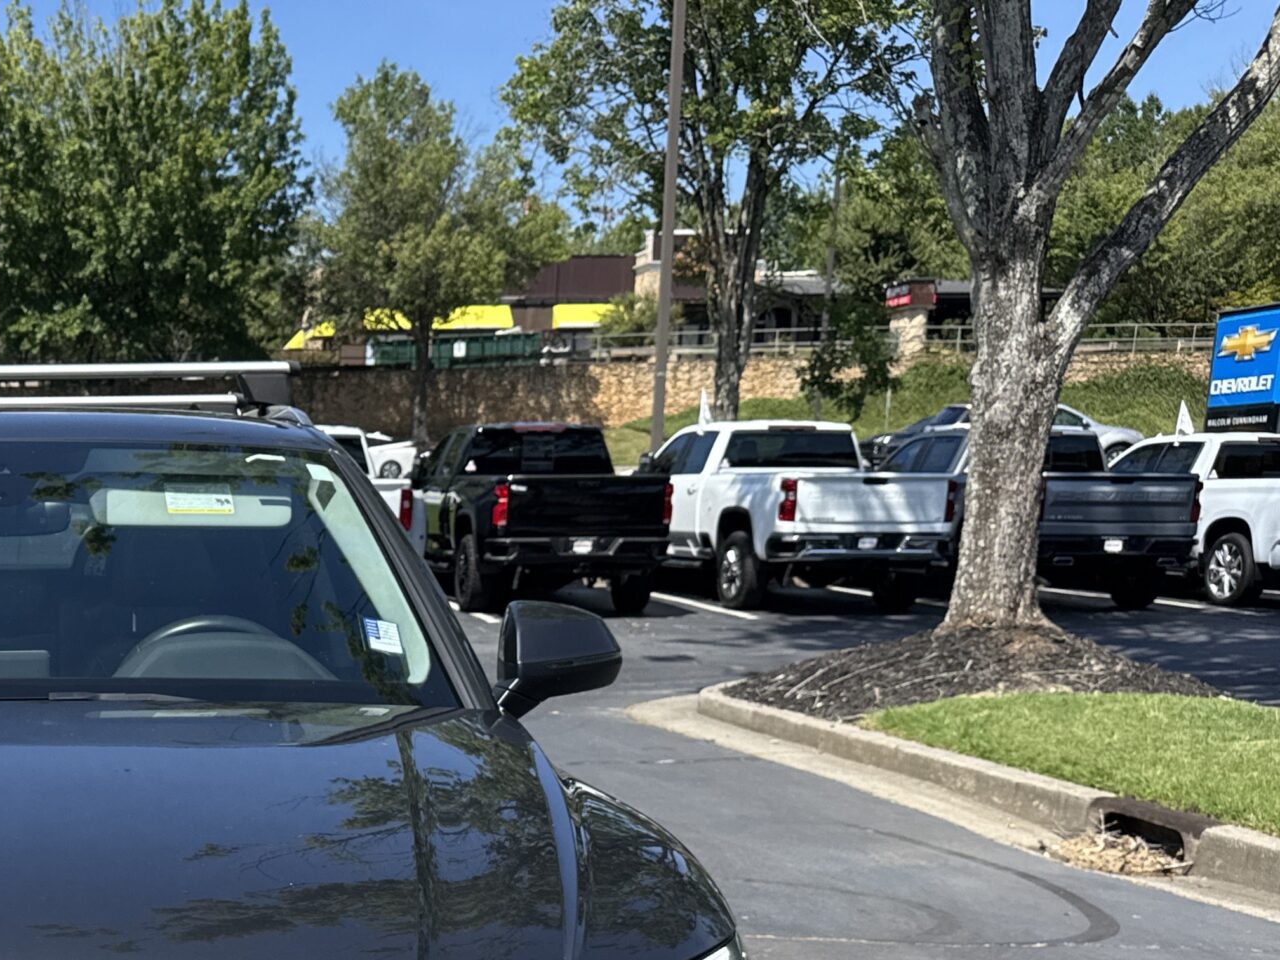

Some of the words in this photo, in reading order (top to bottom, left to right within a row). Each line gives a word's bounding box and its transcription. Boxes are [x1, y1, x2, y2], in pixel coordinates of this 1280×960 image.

[1210, 374, 1274, 395] CHEVROLET
[1207, 417, 1231, 428] MALCOLM
[1232, 415, 1268, 426] CUNNINGHAM
